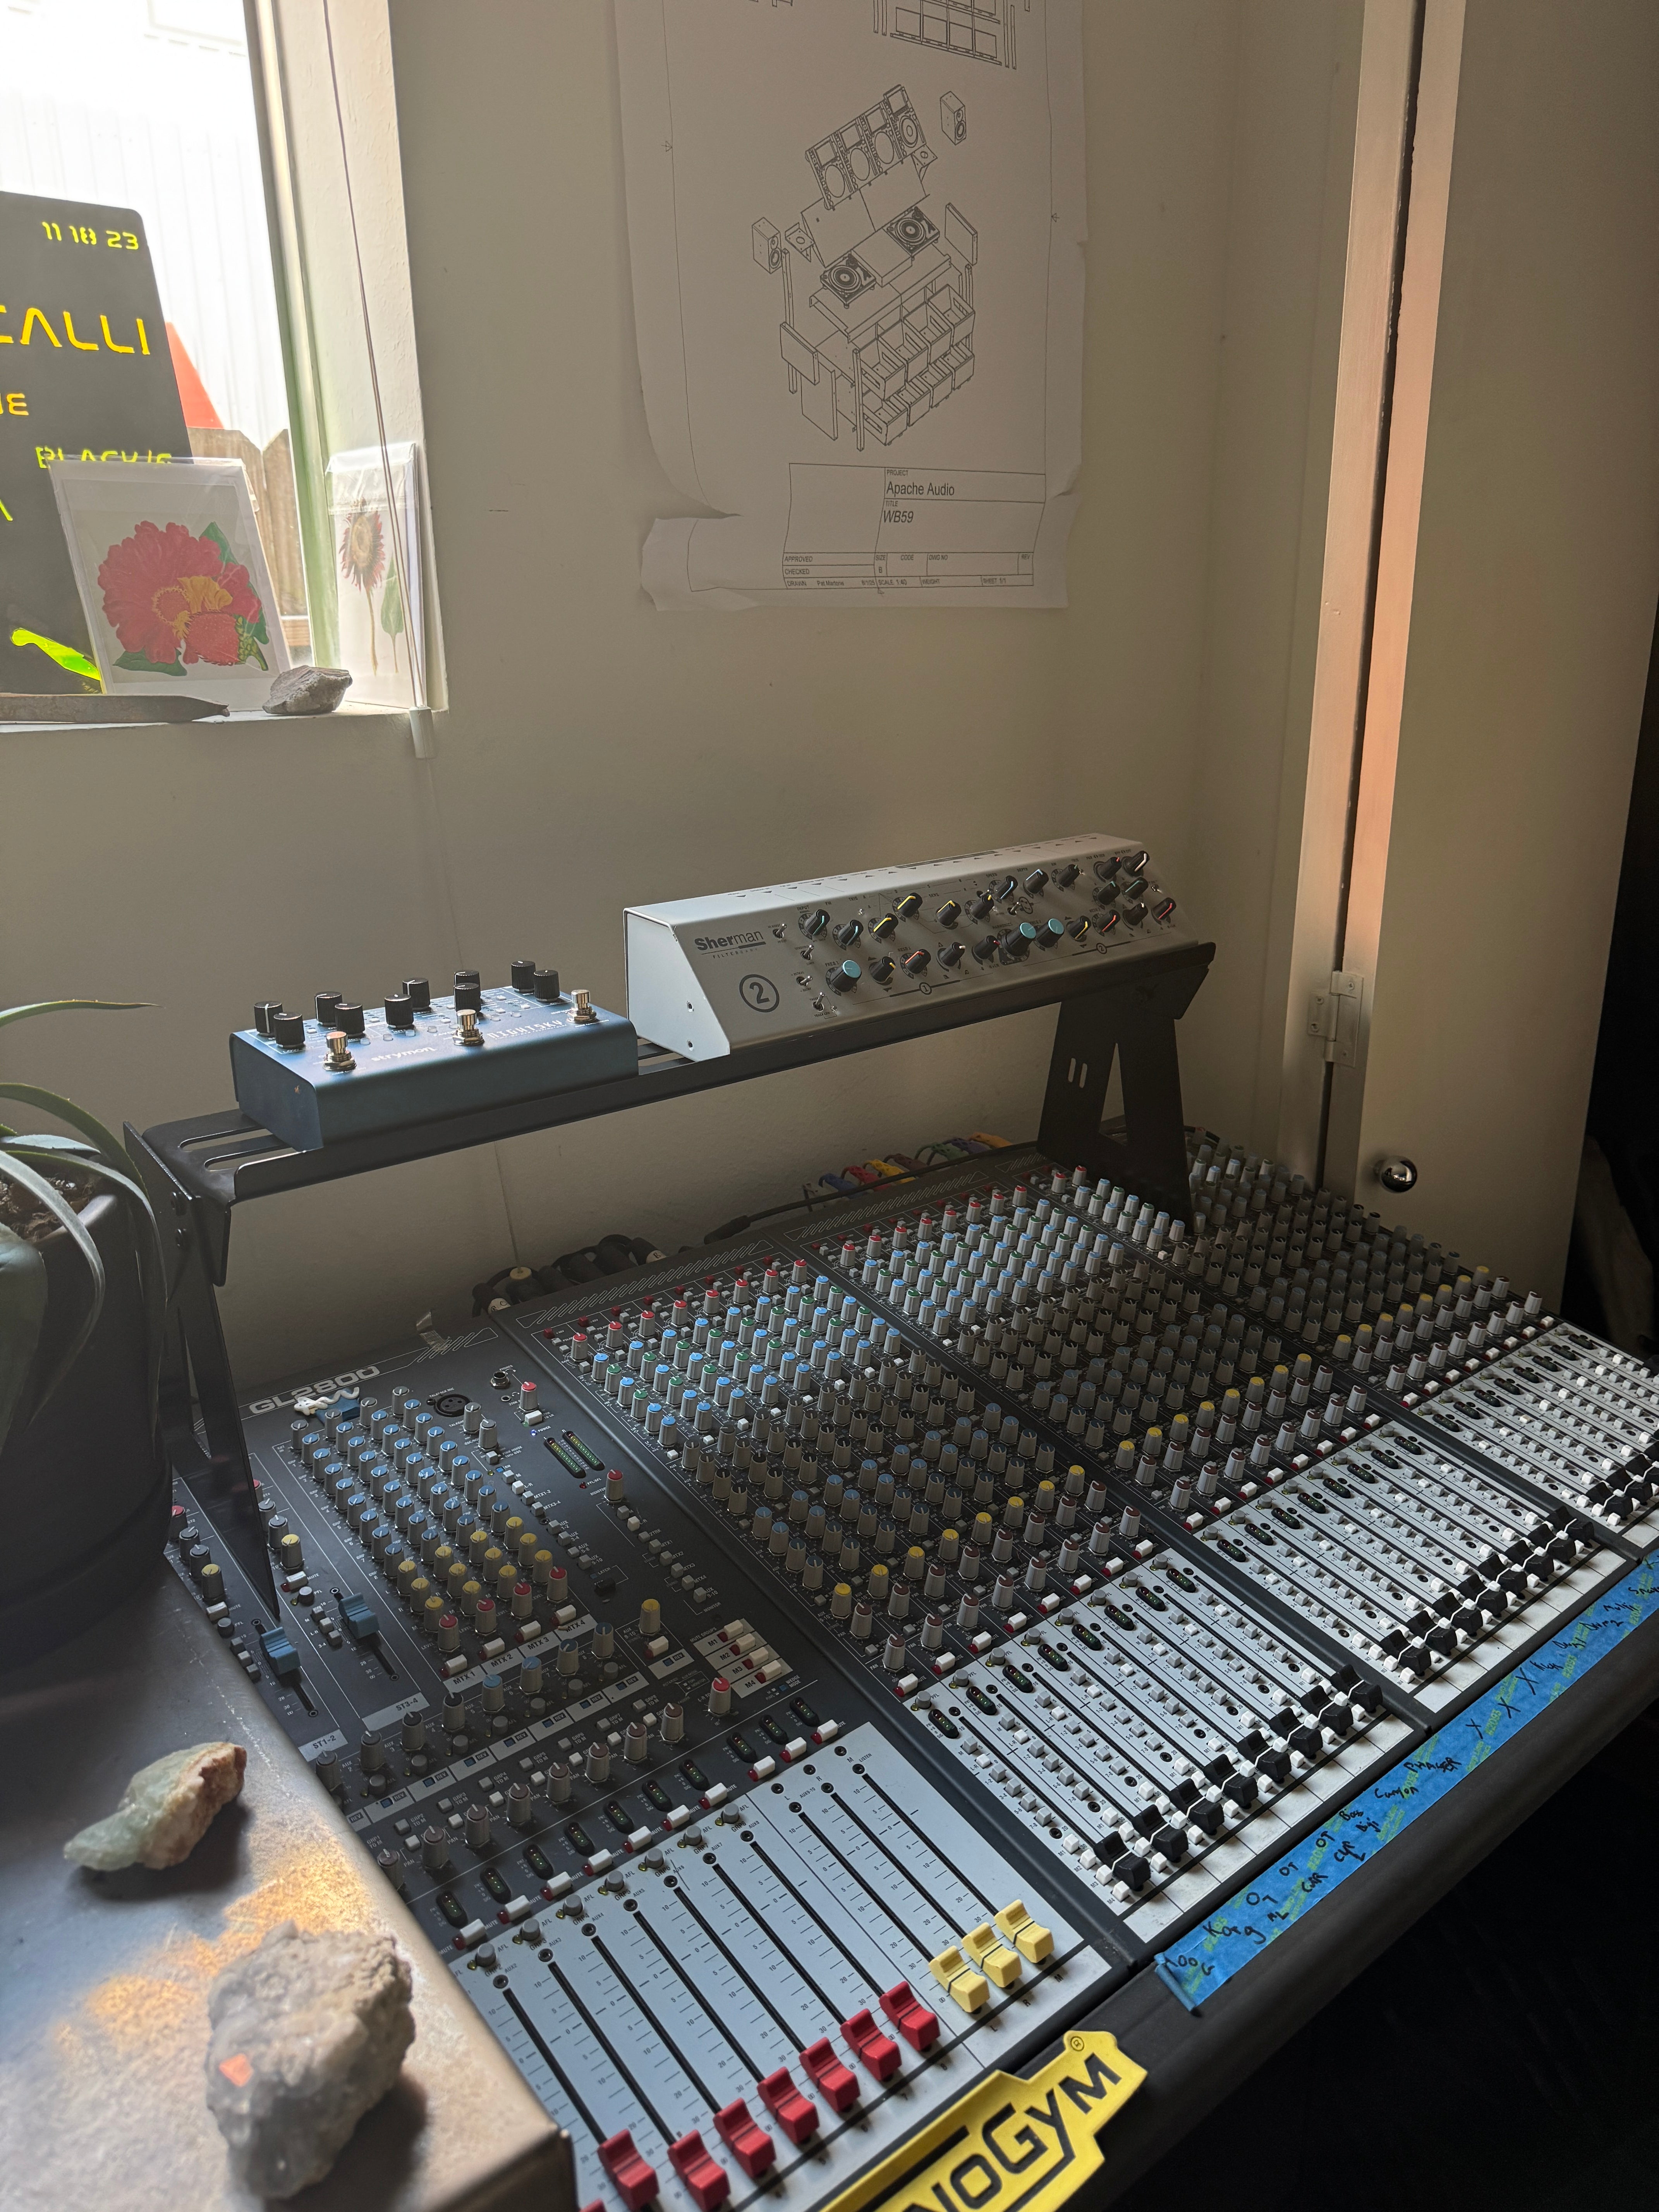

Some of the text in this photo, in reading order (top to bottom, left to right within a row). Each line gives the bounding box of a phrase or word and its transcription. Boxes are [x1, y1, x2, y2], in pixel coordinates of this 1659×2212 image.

[41, 222, 139, 250] 11 18 23
[886, 481, 955, 497] Apache Audio
[884, 510, 914, 523] WB59
[694, 931, 764, 951] Sherman
[749, 982, 770, 1004] 2
[371, 1046, 438, 1062] strymon
[249, 1365, 380, 1414] GL2800
[533, 1490, 551, 1500] MTX1-2
[543, 1501, 561, 1510] MTX3-4
[598, 1567, 611, 1575] LATCH
[703, 1602, 721, 1613] MONITOR
[624, 1631, 637, 1639] 9-10
[690, 1627, 717, 1643] MUTE GROUPS
[421, 1642, 434, 1650] LEVEL
[527, 1640, 542, 1650] MTX
[720, 1652, 731, 1661] M2
[491, 1657, 506, 1668] MTX
[732, 1666, 743, 1674] M3
[453, 1675, 469, 1685] MTX
[745, 1680, 756, 1688] M4
[786, 1674, 800, 1685] WEDGE
[788, 1679, 801, 1688] MODE
[592, 1694, 602, 1702] REV
[396, 1698, 418, 1711] ST3-4
[555, 1713, 565, 1722] REV
[609, 1713, 621, 1722] GRP7
[312, 1735, 337, 1749] ST1-2
[384, 1741, 395, 1749] AUX
[859, 1753, 872, 1763] LISTEN
[970, 1764, 979, 1772] L-R
[799, 1787, 816, 1799] AUX9-10
[1374, 1786, 1419, 1800] Canyon
[739, 1803, 749, 1812] AFL
[410, 1814, 424, 1823] GRP2
[731, 1821, 747, 1833] GRP8
[748, 1820, 760, 1829] AUX8
[367, 1835, 381, 1844] GRP1
[447, 1836, 459, 1844] PAN
[1315, 1831, 1336, 1848] OT
[693, 1843, 709, 1855] GRP7
[711, 1842, 723, 1852] AUX7
[404, 1859, 415, 1867] PAN
[654, 1865, 671, 1878] GRP6
[672, 1865, 685, 1875] AUX6
[1074, 1865, 1083, 1873] M2
[1279, 1862, 1299, 1876] OT
[1090, 1881, 1099, 1889] M3
[614, 1888, 631, 1901] GRP5
[633, 1888, 646, 1898] AUX5
[1107, 1897, 1116, 1905] M4
[573, 1913, 590, 1926] GRP4
[591, 1912, 604, 1923] AUX4
[484, 1919, 499, 1930] MUTE
[1202, 1921, 1266, 1944] Korg
[529, 1937, 547, 1951] GRP3
[549, 1937, 562, 1948] AUX3
[497, 1943, 508, 1953] AFL
[485, 1964, 502, 1977] GRP2
[504, 1962, 518, 1974] AUX2
[1054, 1974, 1064, 1982] M
[1023, 1999, 1031, 2007] R
